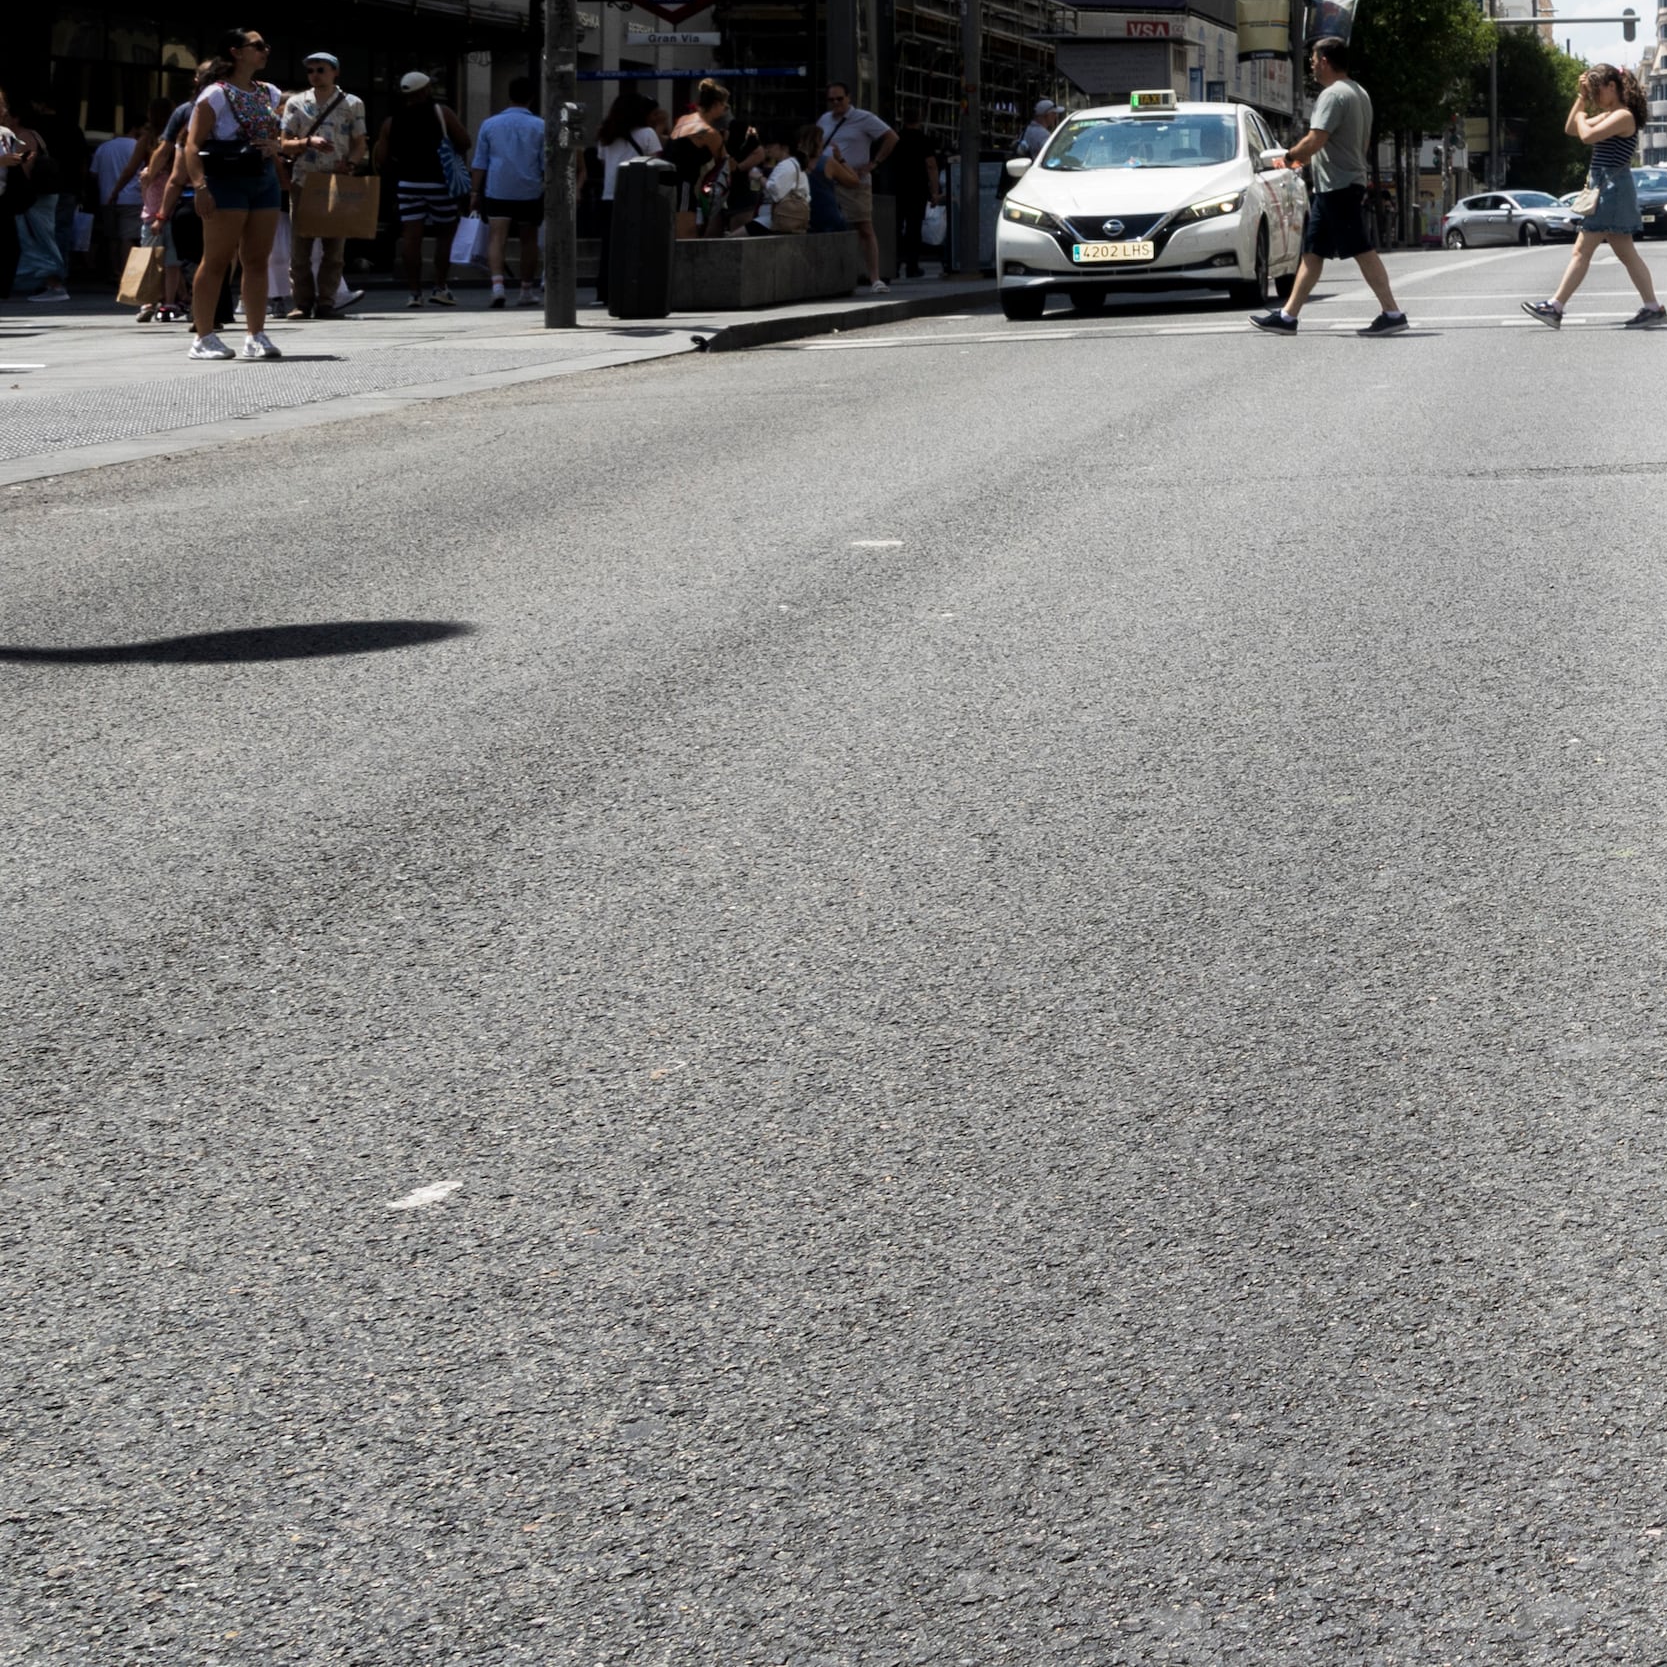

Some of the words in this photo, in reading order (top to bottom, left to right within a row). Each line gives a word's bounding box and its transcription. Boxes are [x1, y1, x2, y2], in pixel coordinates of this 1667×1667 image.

[1130, 22, 1167, 36] VSA
[648, 34, 677, 43] Gran
[1139, 94, 1161, 105] TAXI
[1083, 245, 1119, 258] 4202
[1122, 243, 1151, 257] LHS
